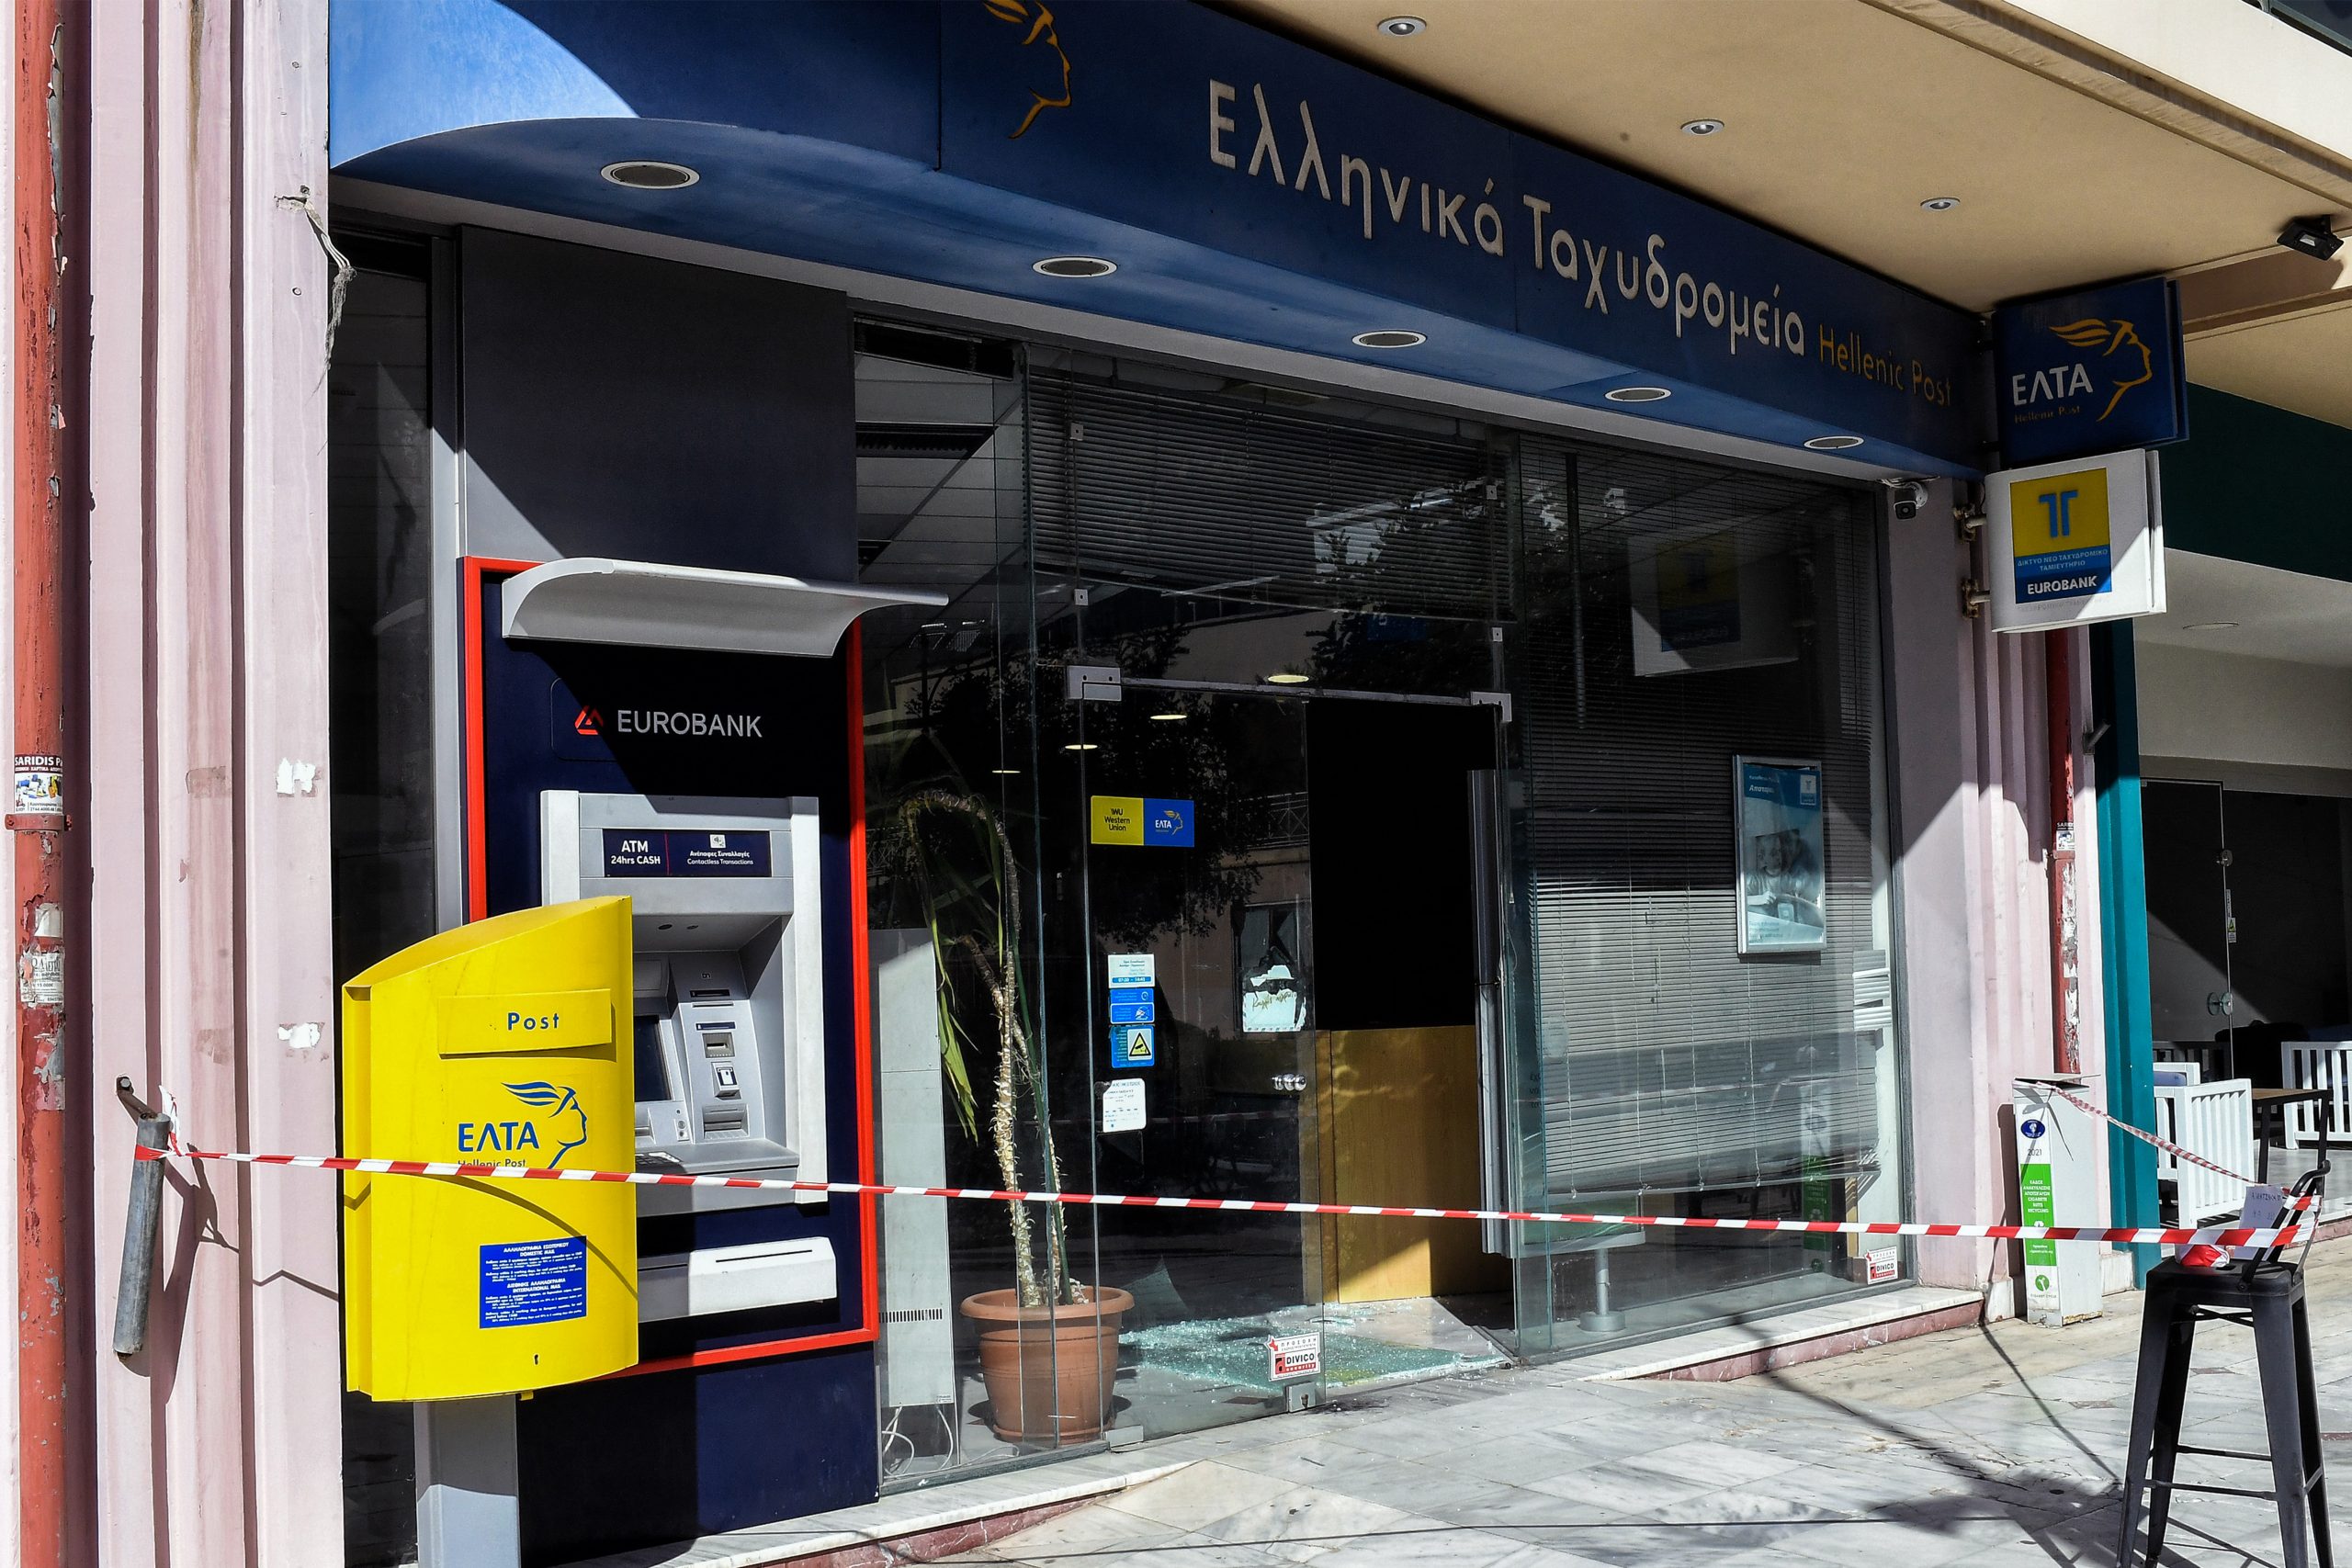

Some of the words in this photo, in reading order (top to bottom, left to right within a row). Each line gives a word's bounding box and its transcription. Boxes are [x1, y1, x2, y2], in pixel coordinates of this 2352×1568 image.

[1209, 78, 1504, 257] Ελληνικά
[1523, 194, 1805, 356] Ταχυδρομεία
[1819, 323, 1905, 391] Hellenic
[1912, 359, 1952, 407] Post
[2058, 405, 2081, 416] Pst
[2018, 558, 2042, 567] ΔΙΚΤΥΟ
[2043, 555, 2058, 563] ΝΕΟ
[2040, 560, 2086, 571] ΤΑΜΙΕΥΤΗΡΙΟ
[2027, 575, 2098, 595] EUROBANK
[617, 710, 763, 738] EUROBANK
[1104, 816, 1131, 824] Western
[621, 840, 649, 852] ATM
[611, 855, 635, 864] 24hrs
[637, 855, 661, 864] CASH
[508, 1012, 560, 1031] Post
[2028, 1148, 2042, 1156] 2021
[504, 1158, 526, 1167] Post
[1877, 1263, 1894, 1271] DIVICO
[1287, 1353, 1315, 1364] DIVICO
